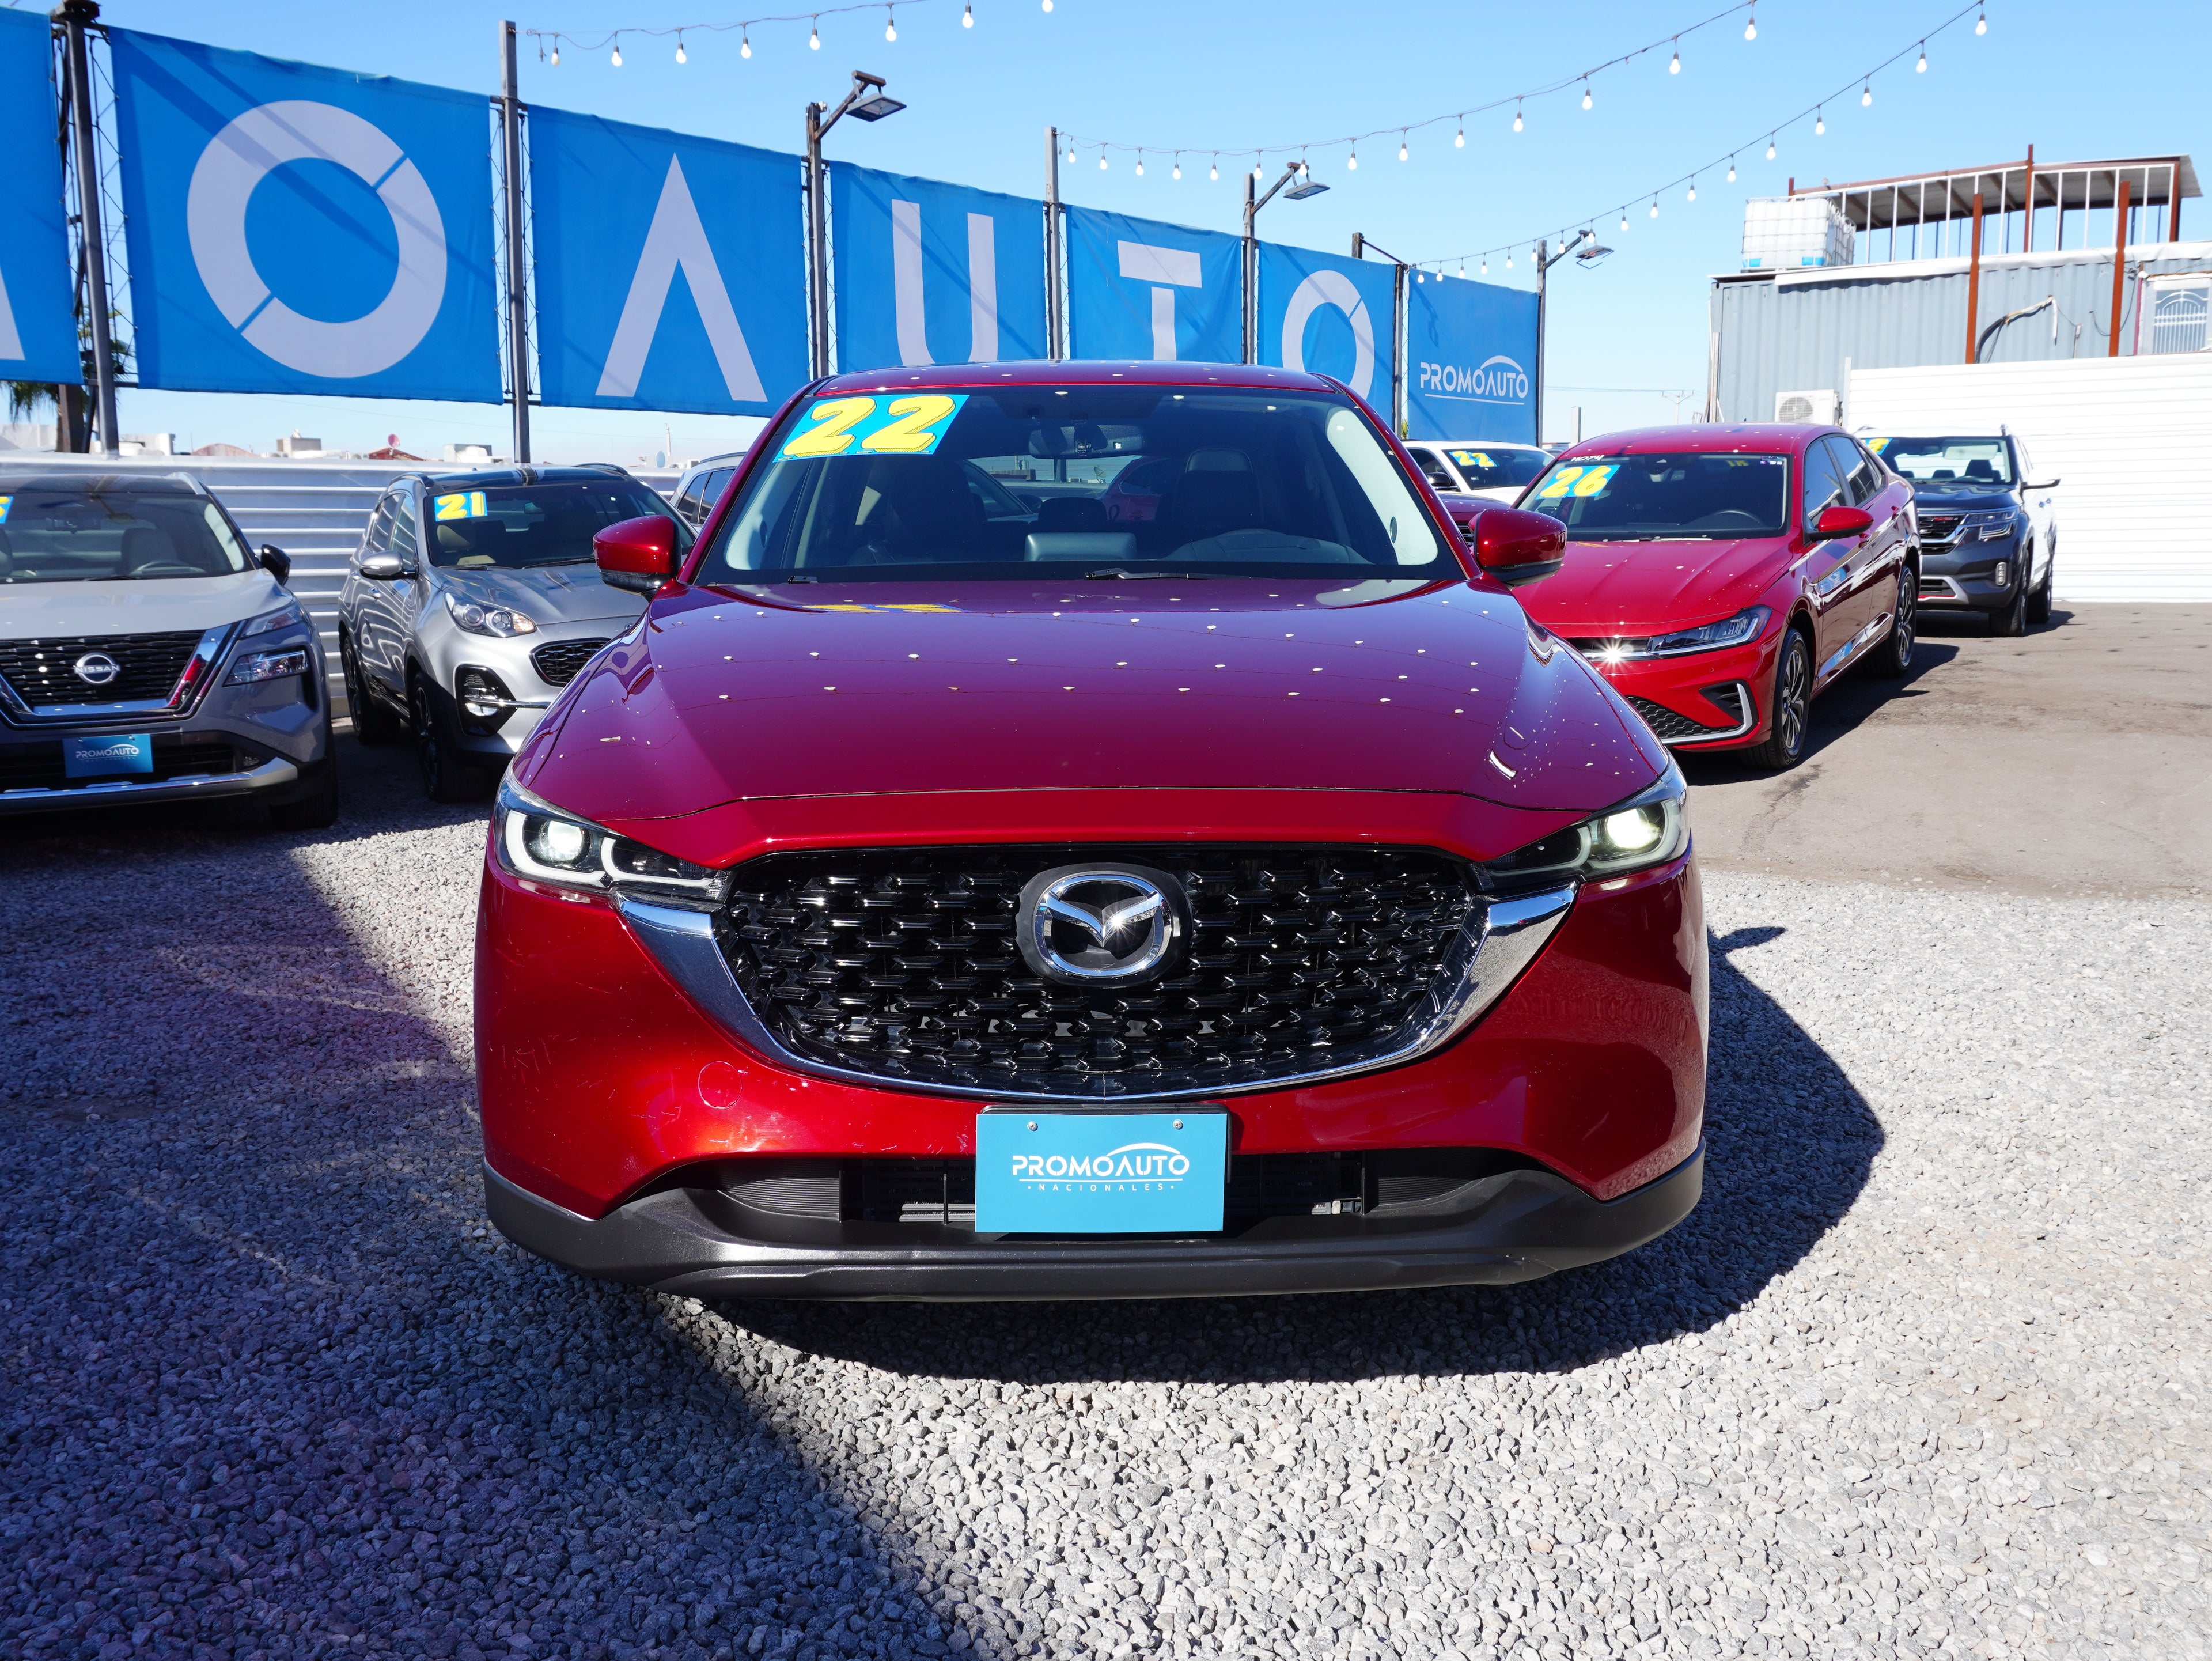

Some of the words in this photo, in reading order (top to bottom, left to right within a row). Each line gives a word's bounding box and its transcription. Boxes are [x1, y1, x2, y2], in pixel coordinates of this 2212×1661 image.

[1420, 361, 1528, 398] PROMOAUTO
[783, 395, 956, 457] 22
[1452, 451, 1495, 467] 22
[1539, 465, 1612, 498] 26
[437, 491, 485, 519] 21
[75, 664, 120, 674] NISSAN
[75, 747, 139, 759] PROMOAUTO
[1012, 1154, 1190, 1177] PROMOAUTO
[1038, 1183, 1164, 1192] NACIONALES
